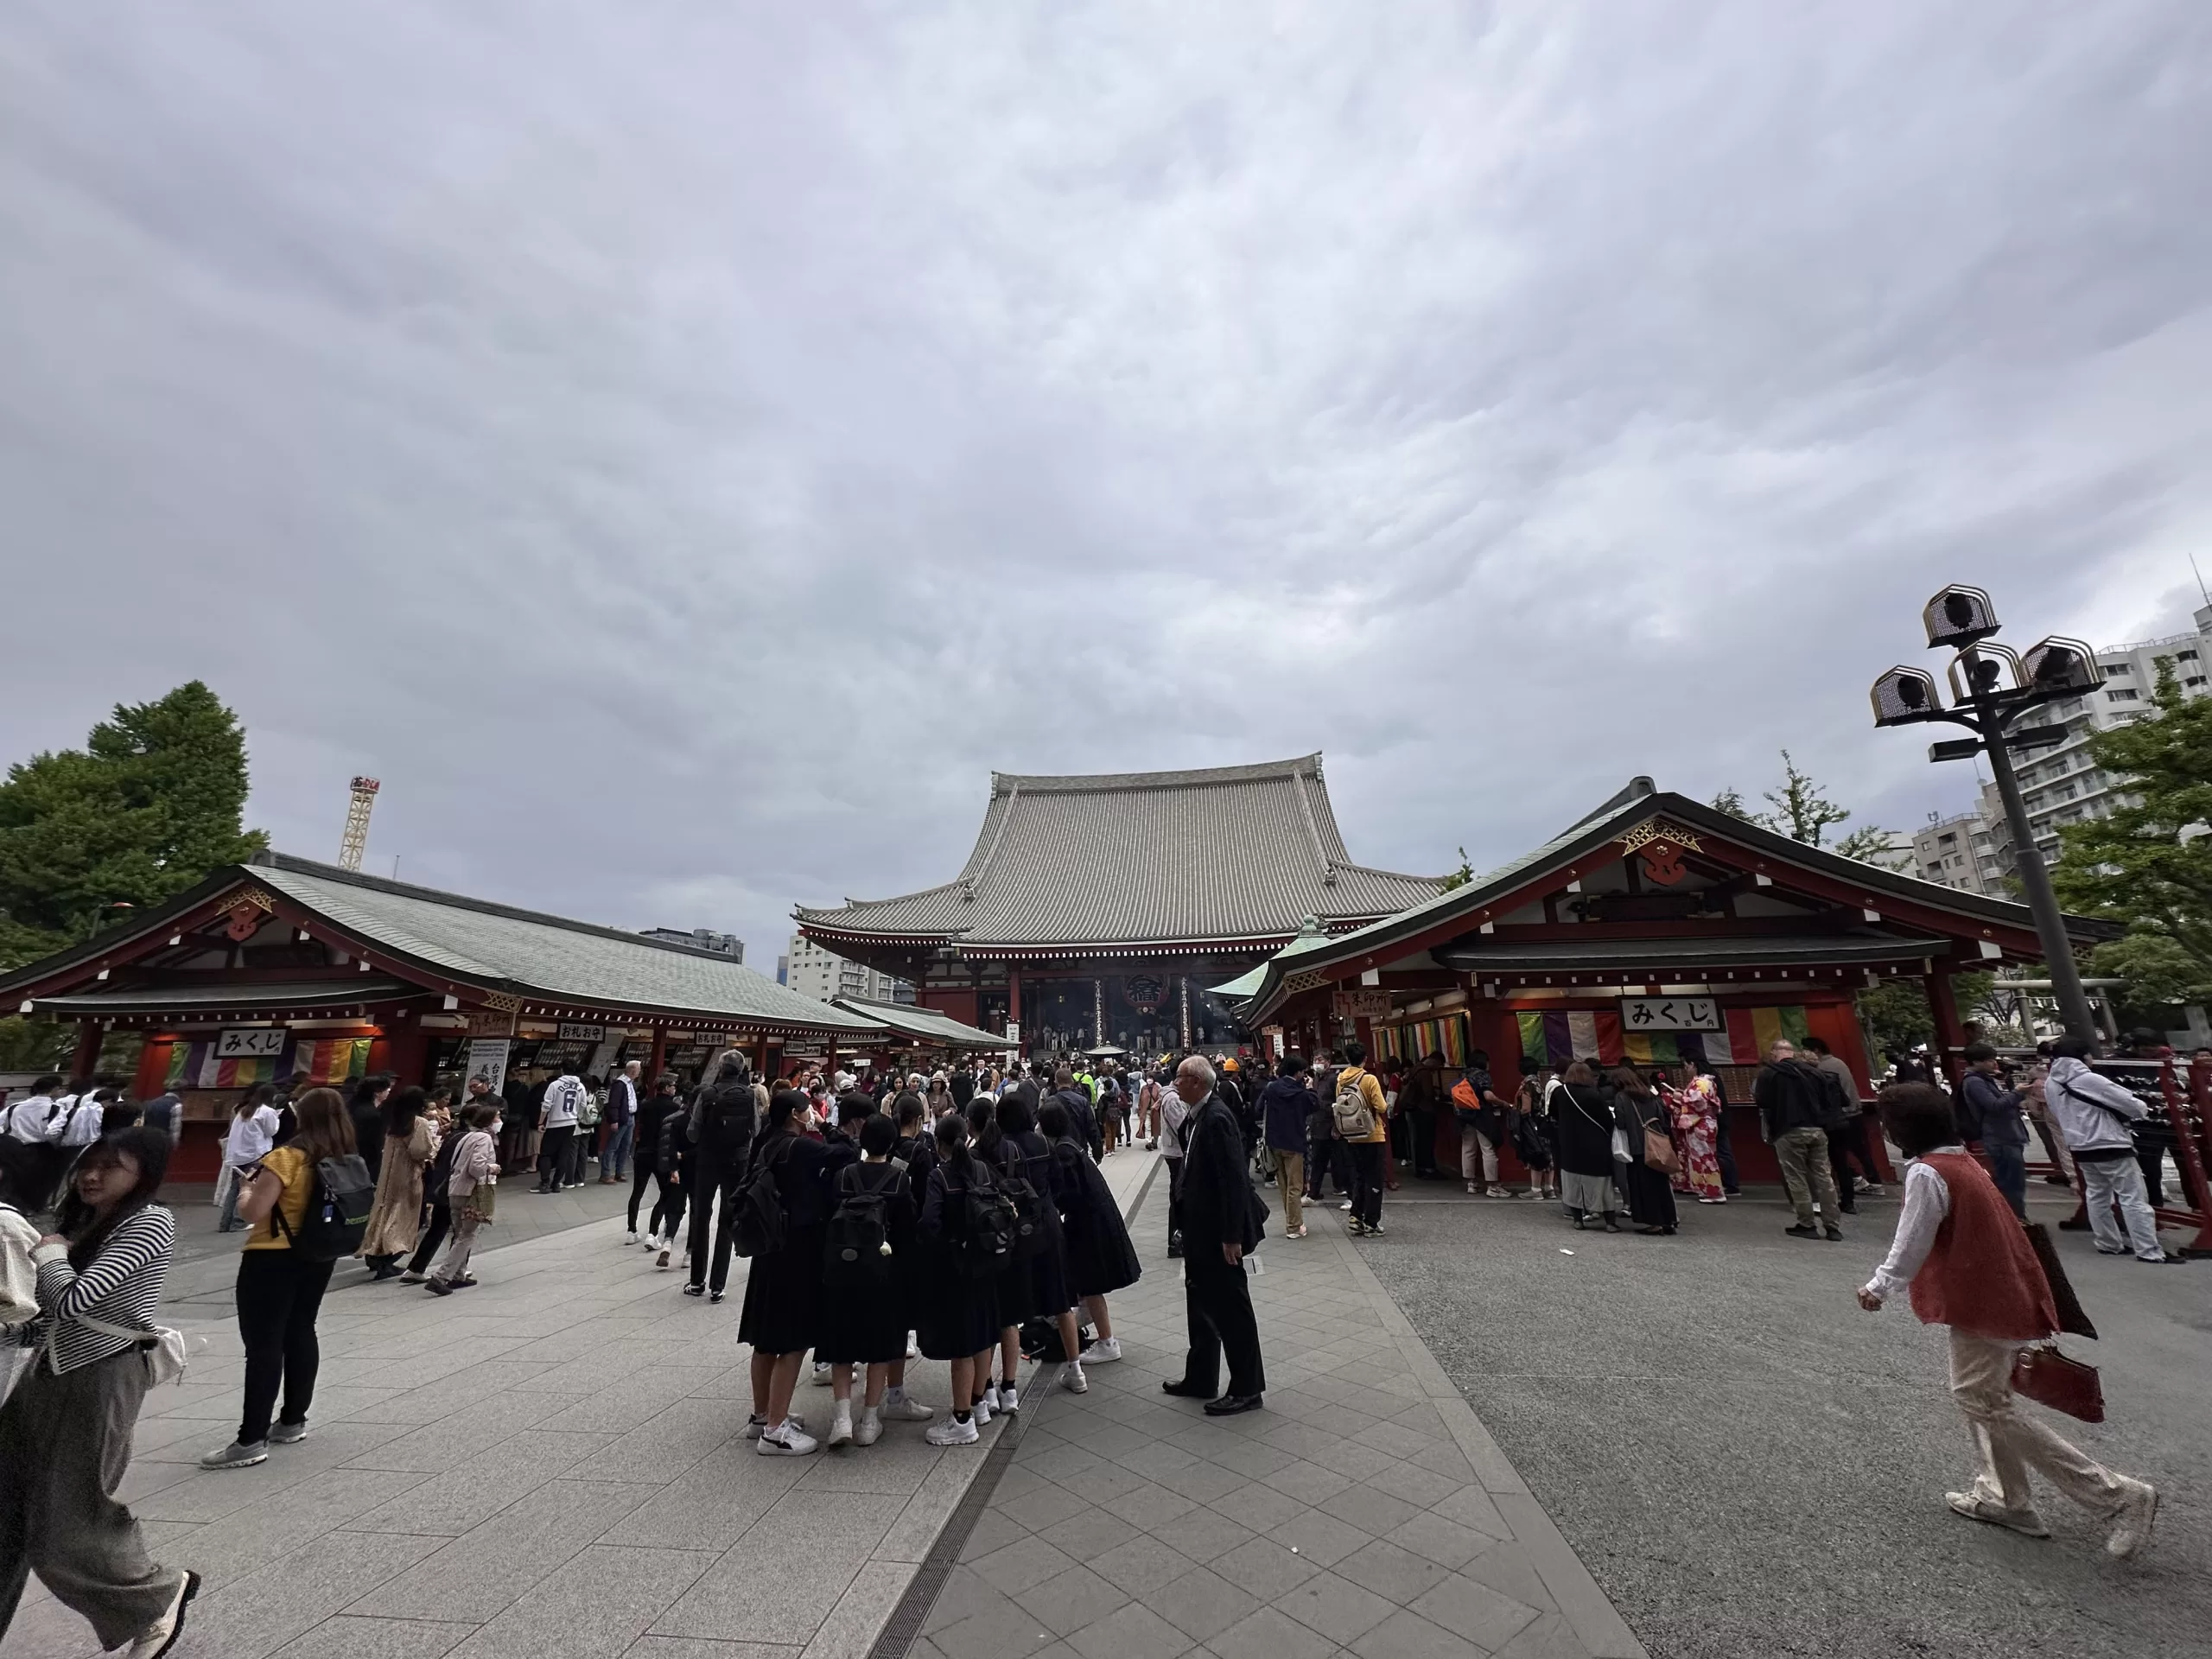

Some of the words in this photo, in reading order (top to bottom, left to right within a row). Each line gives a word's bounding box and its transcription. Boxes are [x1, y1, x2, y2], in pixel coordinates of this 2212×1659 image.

[1632, 1002, 1709, 1025] みくじ
[226, 1033, 281, 1052] みくじ
[563, 1090, 577, 1112] 6
